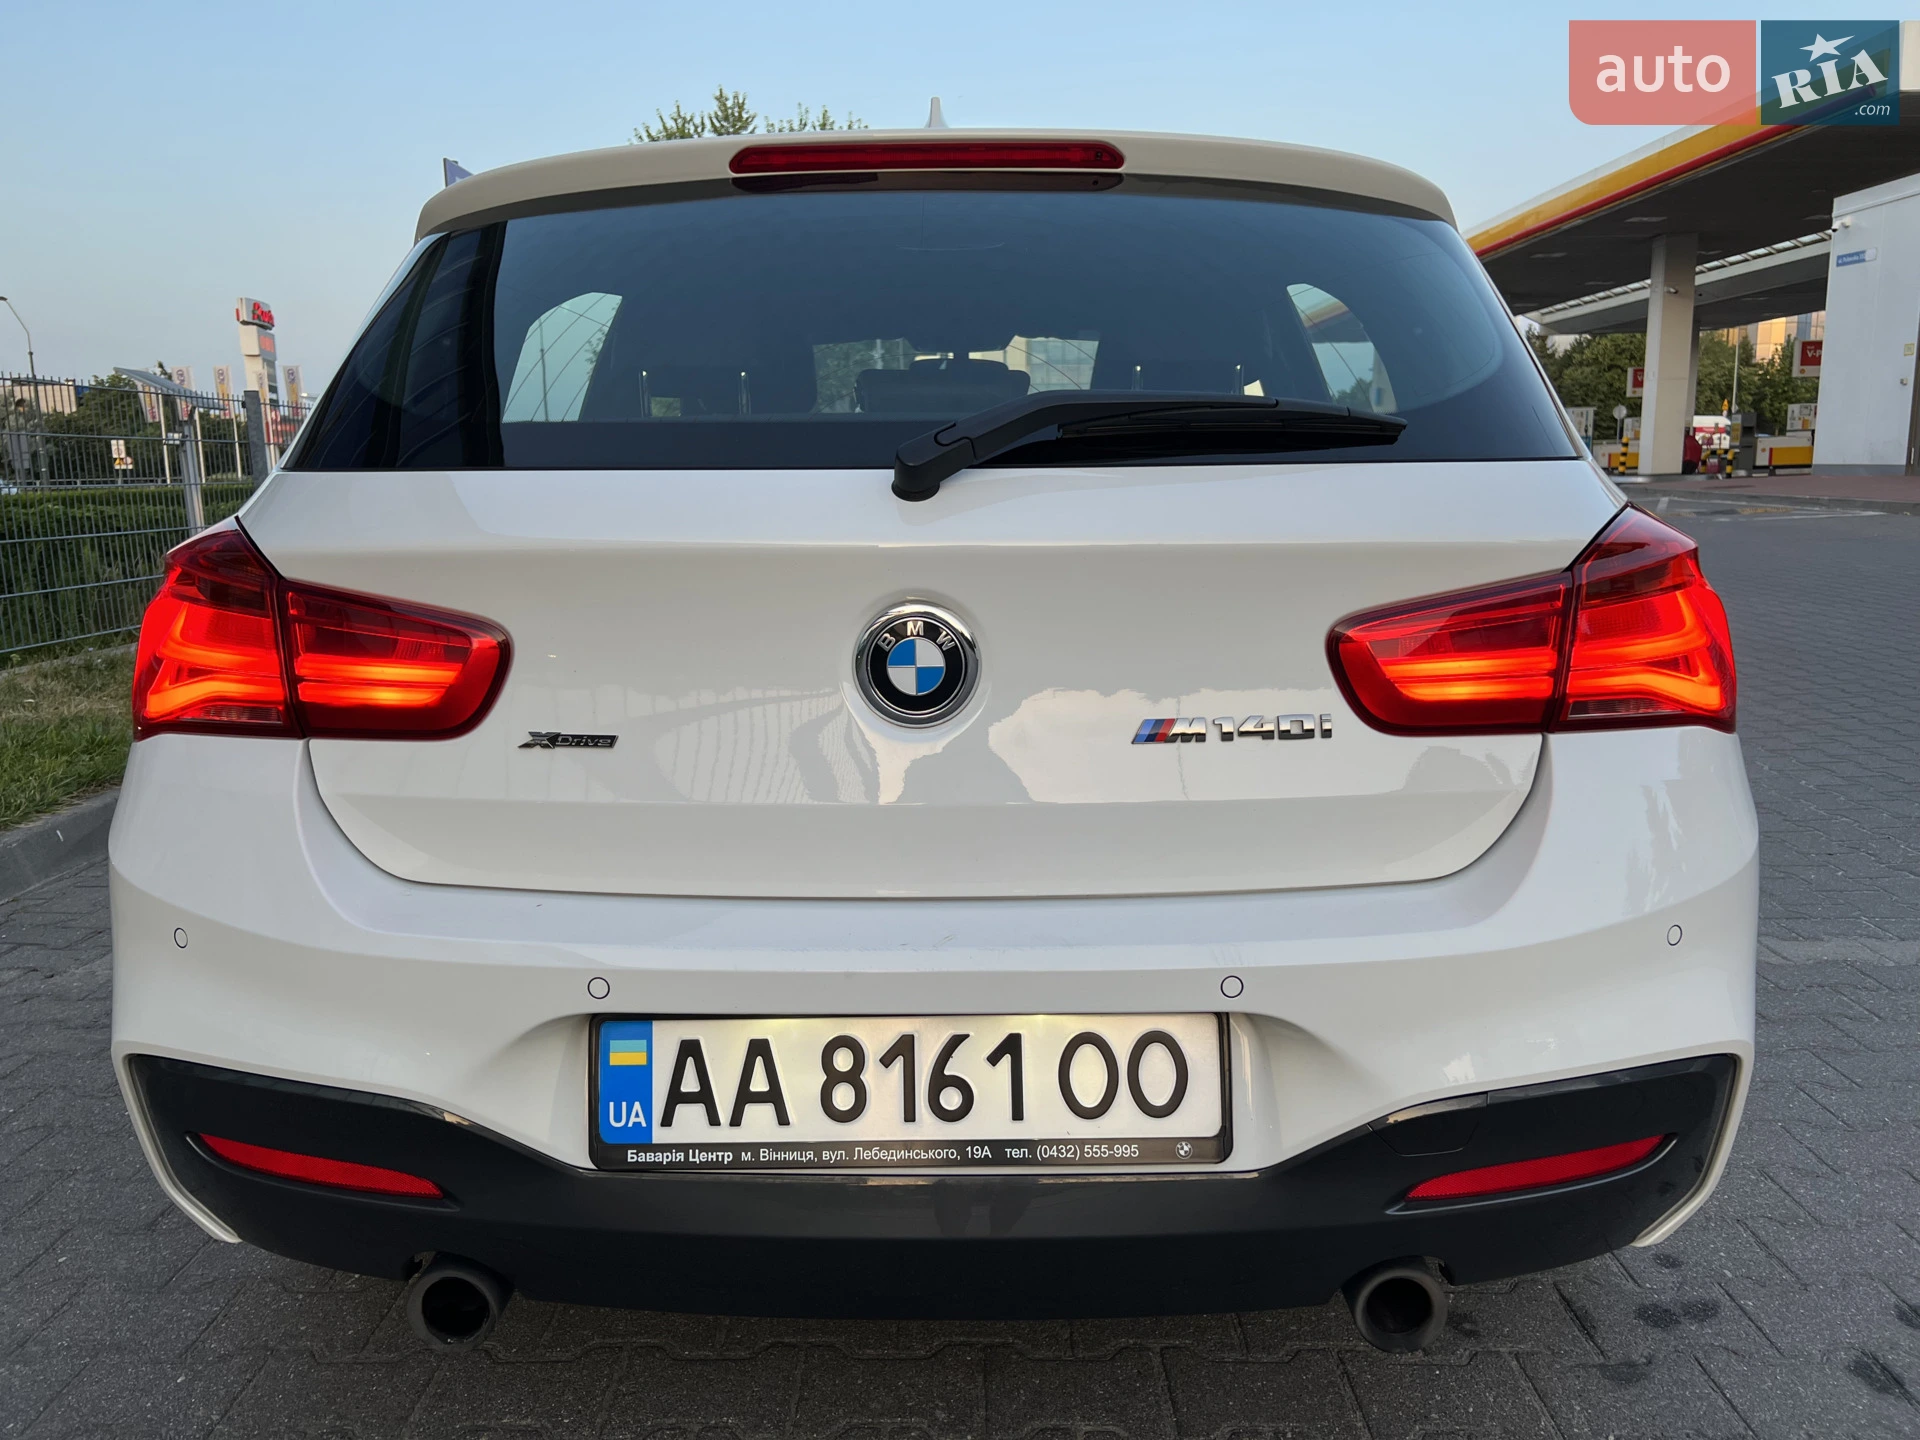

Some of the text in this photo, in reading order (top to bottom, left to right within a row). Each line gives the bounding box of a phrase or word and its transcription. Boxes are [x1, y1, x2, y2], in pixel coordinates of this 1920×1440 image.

[877, 620, 956, 652] BMW
[660, 1038, 791, 1128] AA
[820, 1032, 1025, 1123] 8161
[609, 1101, 647, 1127] UA
[627, 1149, 685, 1165] Баварія
[688, 1149, 733, 1164] Центр
[741, 1152, 755, 1161] м.
[760, 1148, 818, 1163] Вінниця,
[822, 1150, 849, 1163] вул.
[853, 1146, 961, 1164] Лебединського,
[1004, 1148, 1032, 1159] тел.
[1036, 1145, 1080, 1161] (0432)
[1083, 1144, 1139, 1158] 555-995
